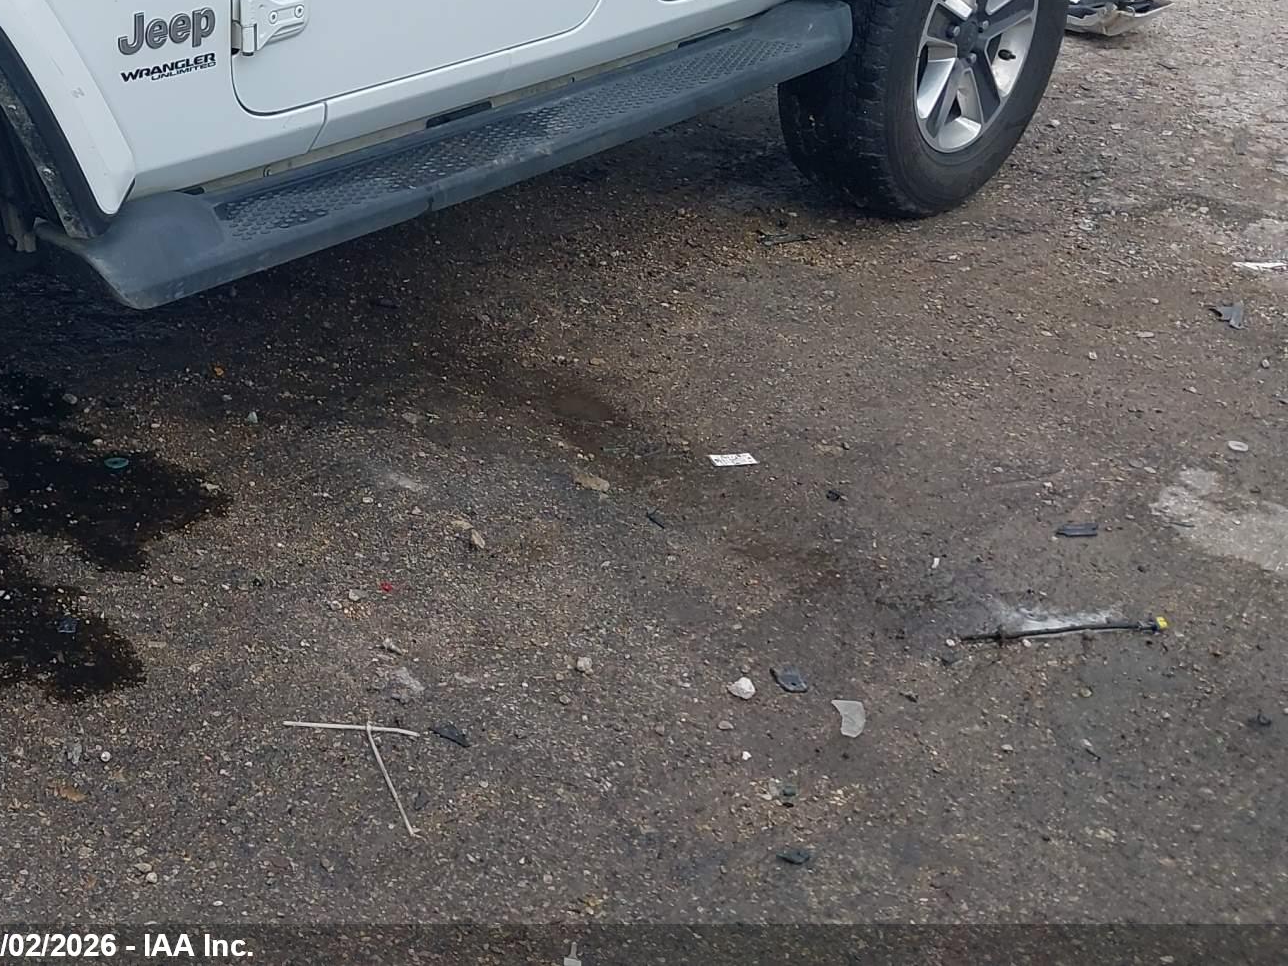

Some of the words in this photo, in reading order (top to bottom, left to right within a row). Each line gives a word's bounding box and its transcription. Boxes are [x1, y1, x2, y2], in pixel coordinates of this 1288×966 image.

[117, 7, 216, 56] Jeep
[120, 52, 217, 83] WRANGLER
[151, 61, 217, 81] UNLIMITED
